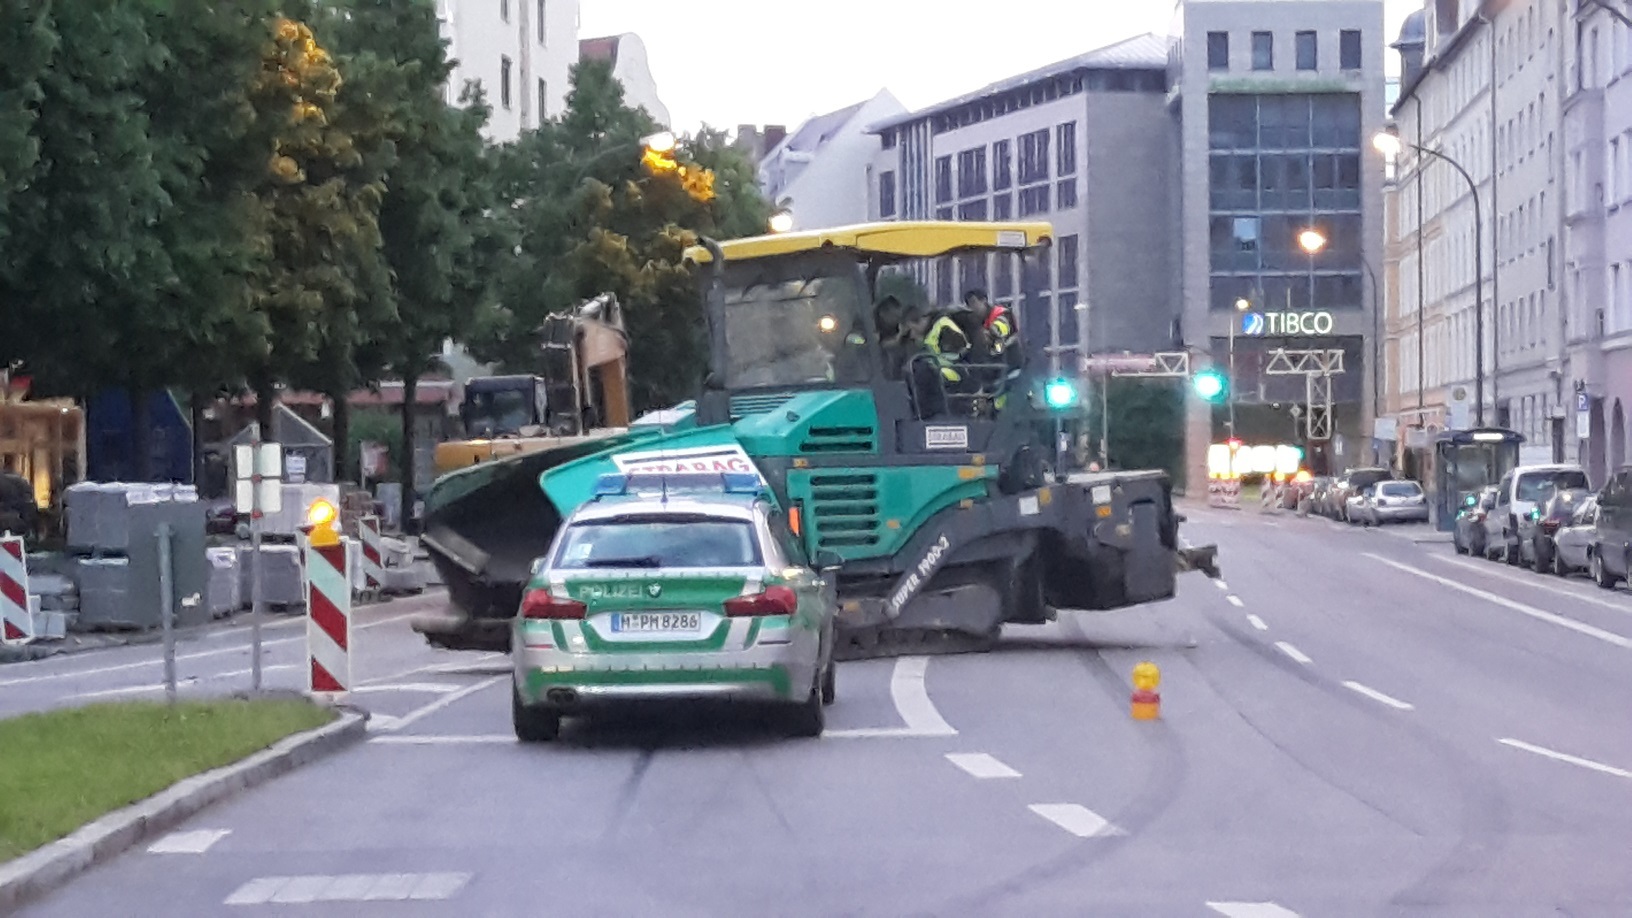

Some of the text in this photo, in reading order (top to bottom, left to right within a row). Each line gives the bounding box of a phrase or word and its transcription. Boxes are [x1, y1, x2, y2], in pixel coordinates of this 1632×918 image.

[1265, 311, 1333, 334] TIBCO
[579, 583, 643, 598] POLIZEI
[891, 574, 920, 611] SUPER
